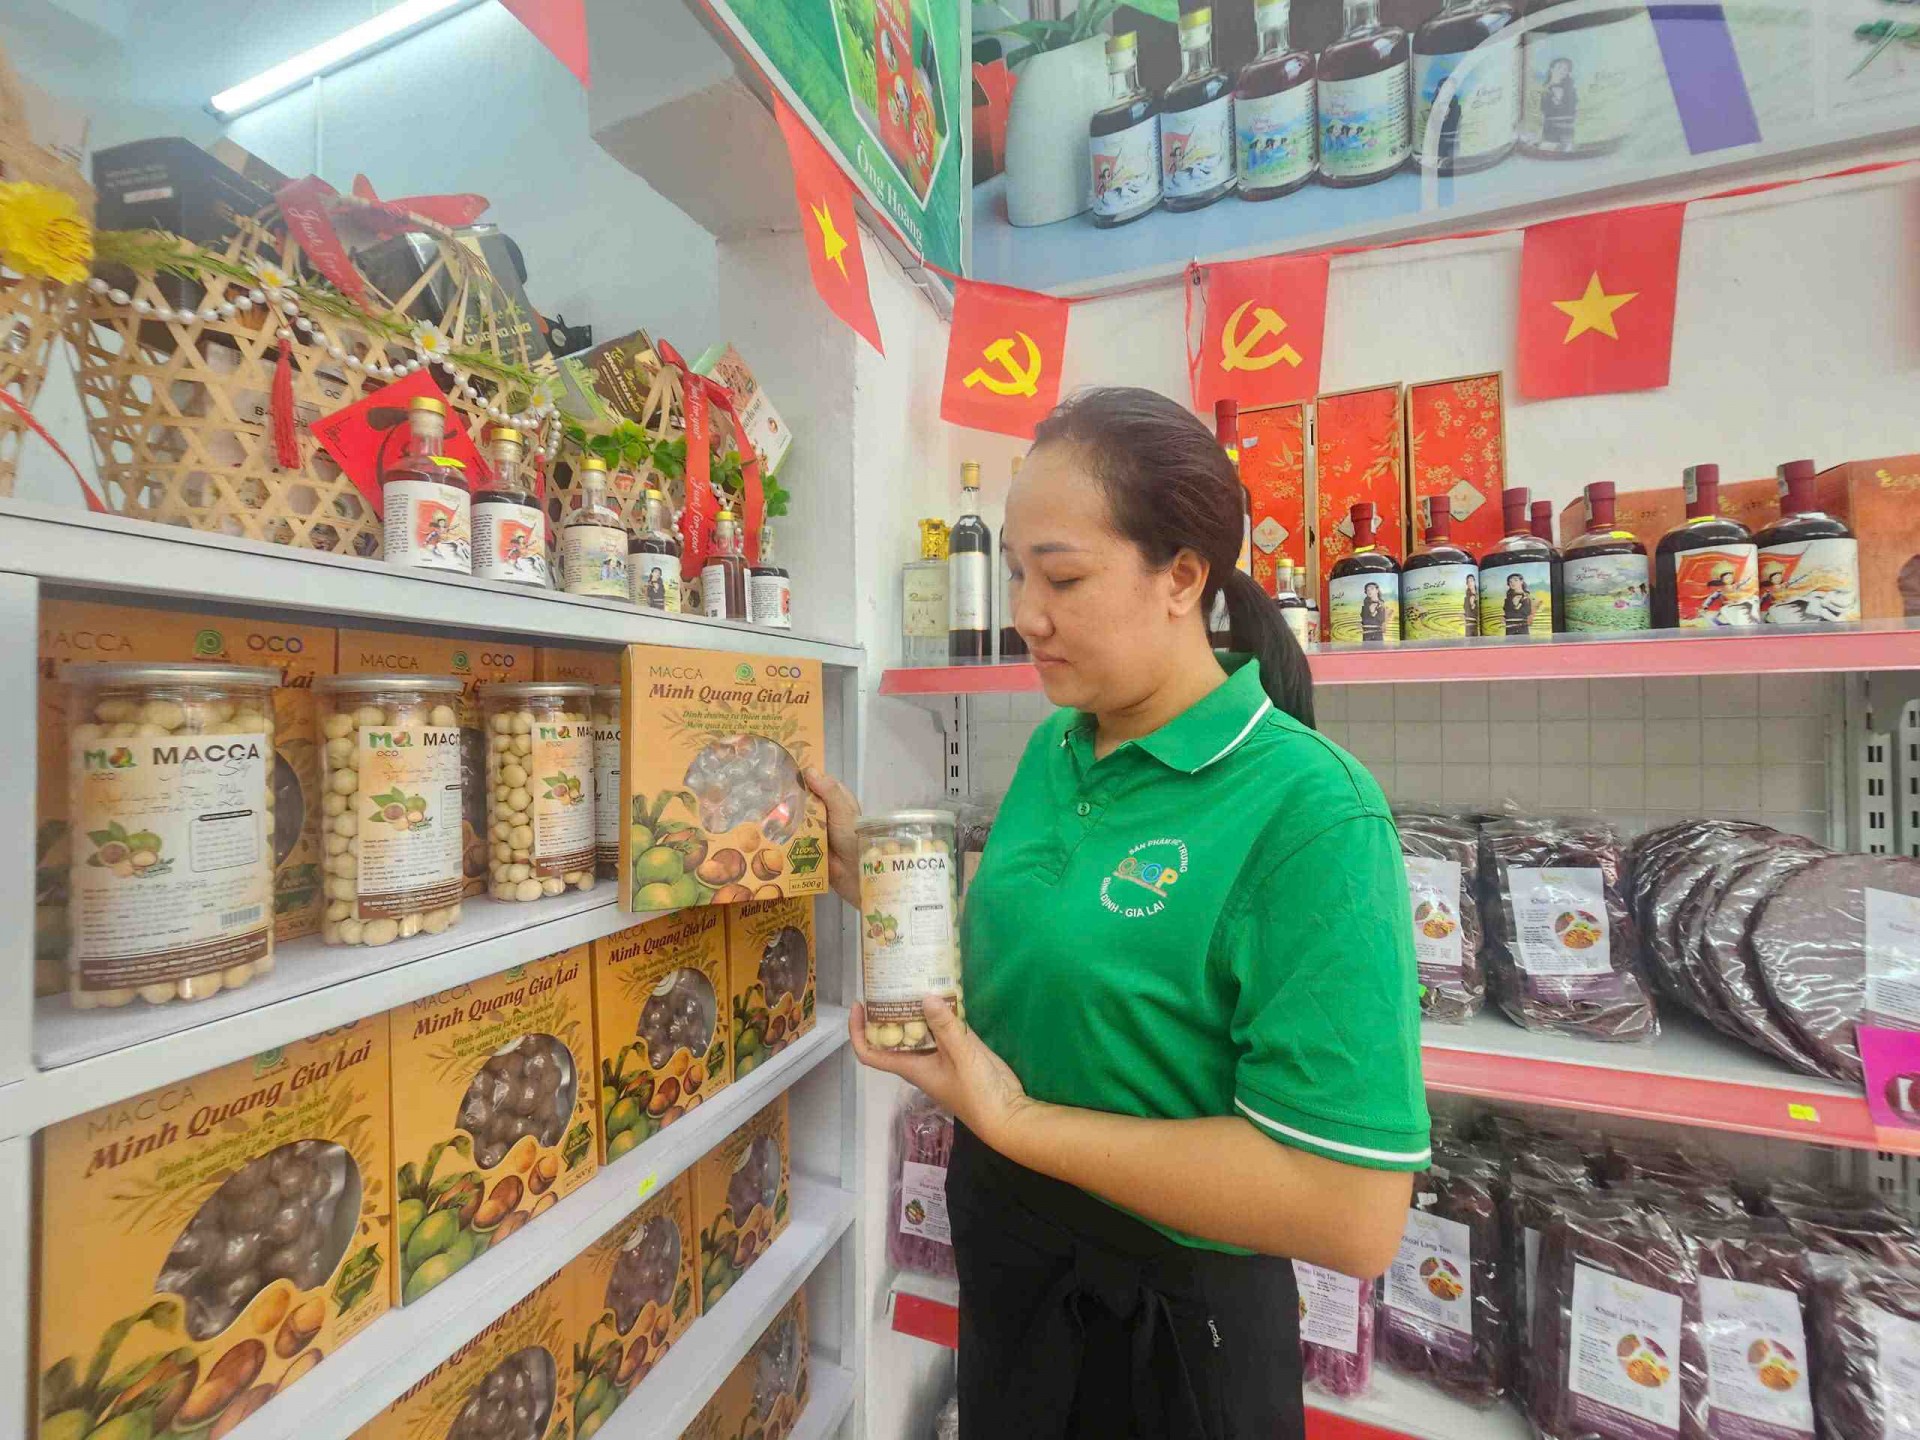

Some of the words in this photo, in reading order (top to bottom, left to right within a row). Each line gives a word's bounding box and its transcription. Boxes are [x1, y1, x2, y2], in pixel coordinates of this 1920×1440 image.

[361, 653, 419, 669] MACCA
[480, 653, 515, 668] OCO
[649, 666, 703, 680] MACCA
[765, 665, 802, 679] OCO
[649, 683, 695, 699] Minh
[699, 685, 753, 706] Quang
[757, 688, 784, 704] Gia
[785, 688, 811, 705] Lai
[153, 743, 260, 765] MACCA
[893, 858, 946, 872] MACCA
[801, 881, 816, 889] 500
[1125, 908, 1145, 918] GIA
[1146, 900, 1165, 916] LAI
[608, 942, 641, 965] Minh
[643, 929, 681, 955] Quang
[682, 923, 700, 938] Gia
[701, 915, 717, 932] Lai
[413, 1007, 464, 1040] Minh
[468, 986, 525, 1022] Quang
[528, 976, 553, 996] Gia
[556, 963, 579, 985] Lai
[84, 1121, 180, 1179] Minh
[187, 1079, 286, 1139] Quang
[290, 1061, 331, 1092] Gia
[335, 1040, 373, 1073] Lai
[85, 1085, 197, 1143] MACCA
